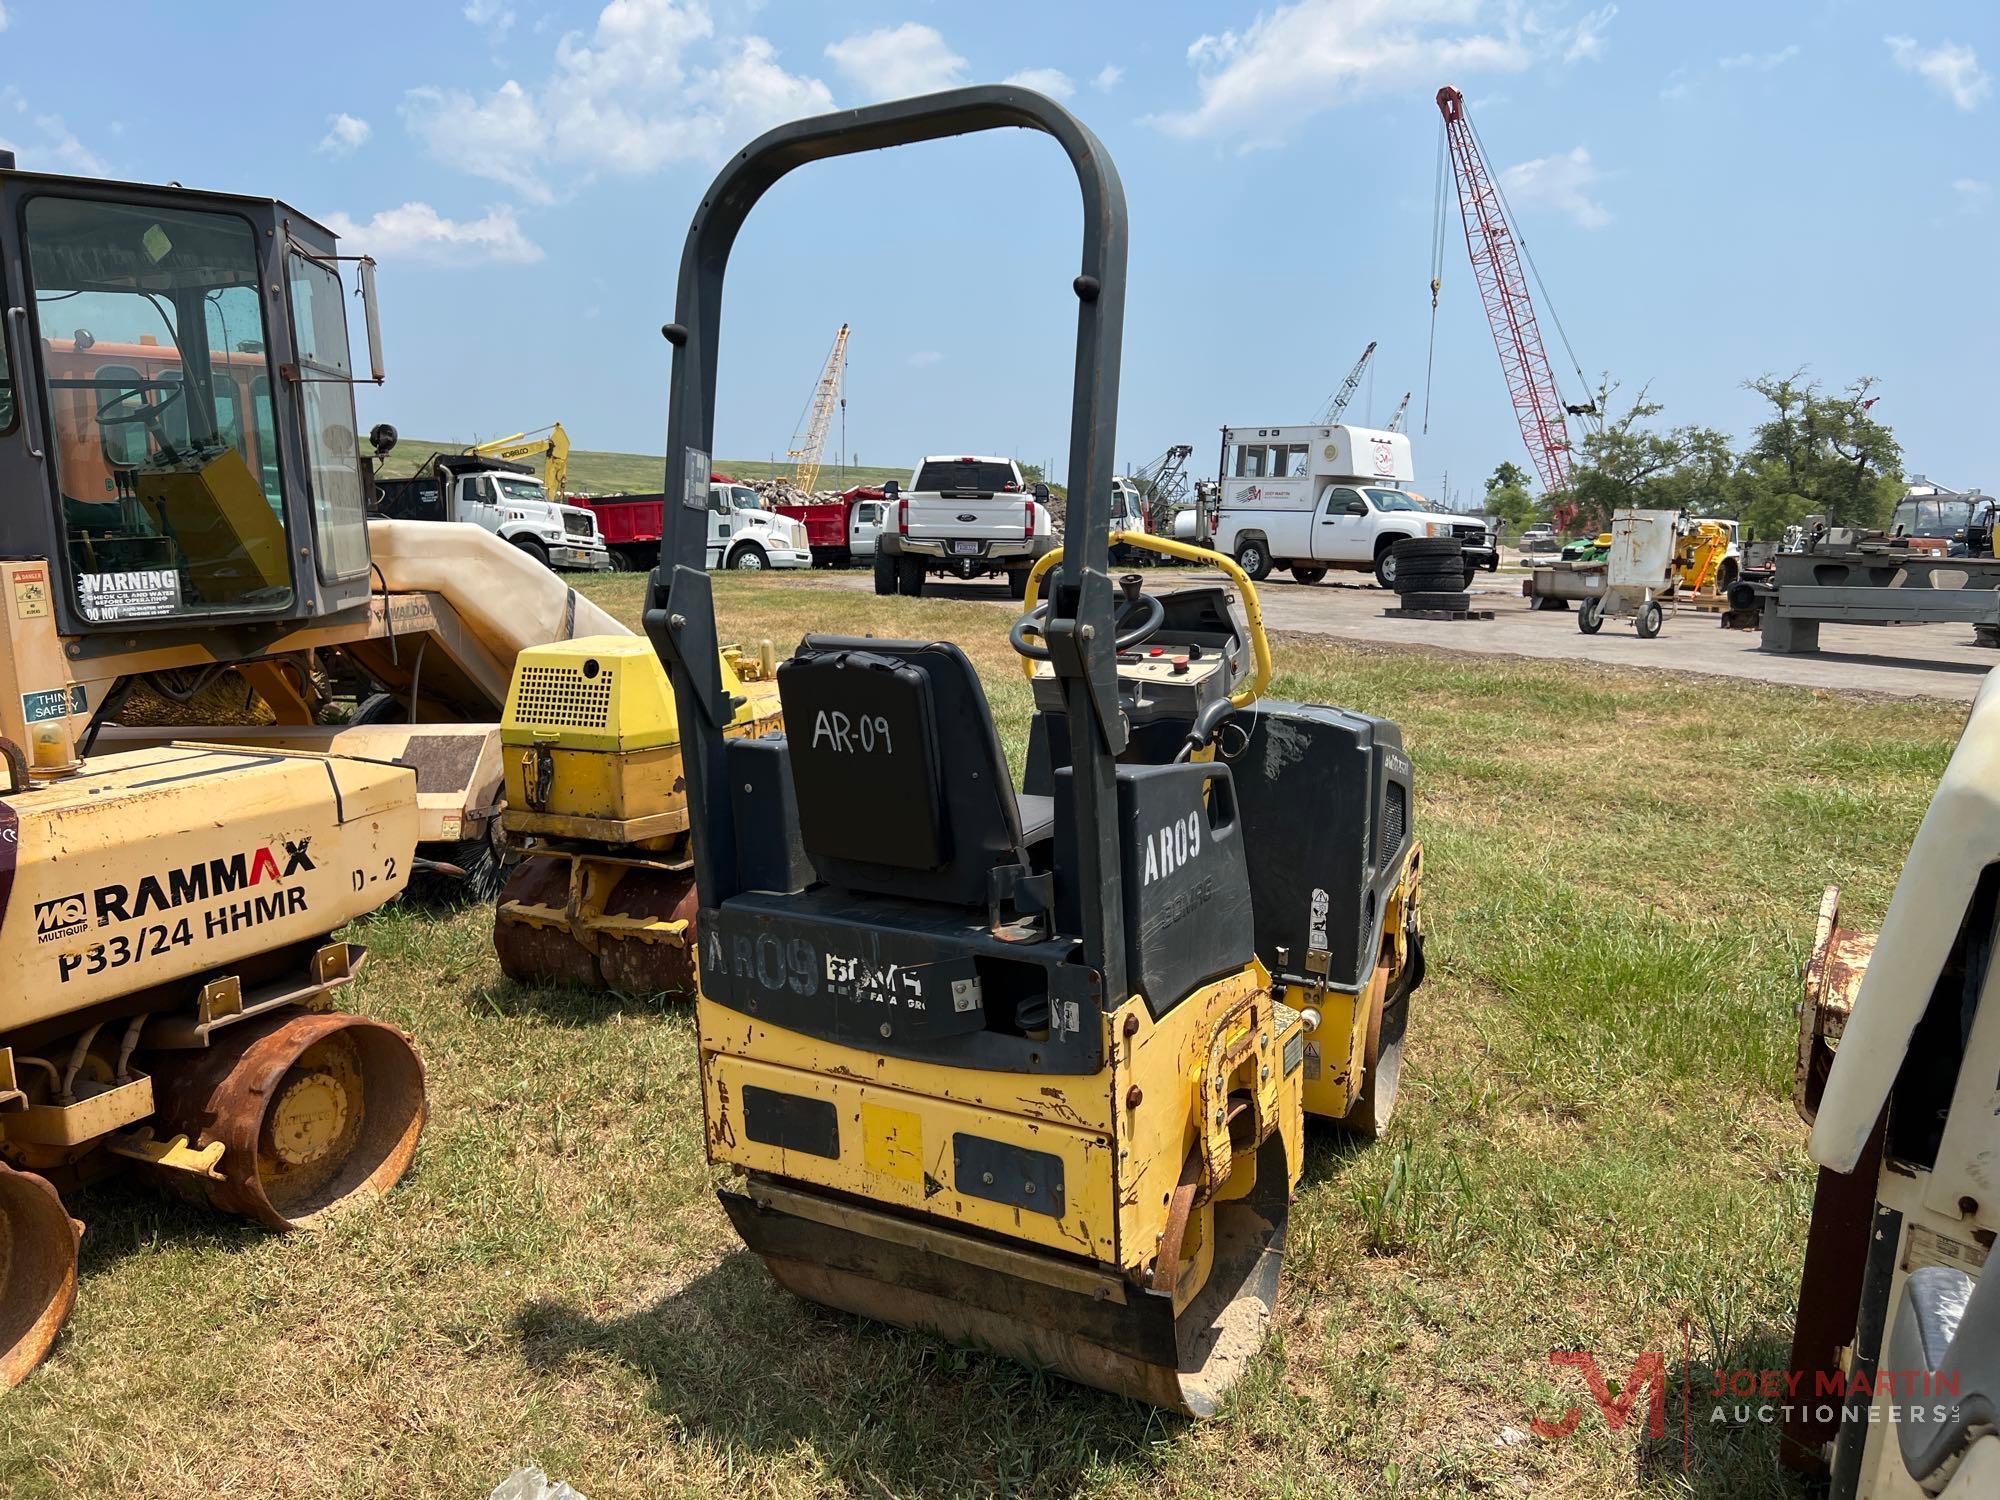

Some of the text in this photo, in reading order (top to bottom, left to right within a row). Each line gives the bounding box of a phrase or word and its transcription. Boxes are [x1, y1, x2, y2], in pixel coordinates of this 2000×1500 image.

[502, 447, 528, 458] KOBELCO
[86, 606, 118, 620] DO NOT
[812, 710, 892, 754] AR-09
[1144, 810, 1200, 886] AR09
[93, 836, 316, 928] RAMMAX
[38, 924, 88, 944] MULTIQUIP
[204, 885, 309, 940] HHMR
[59, 917, 194, 984] P33/24
